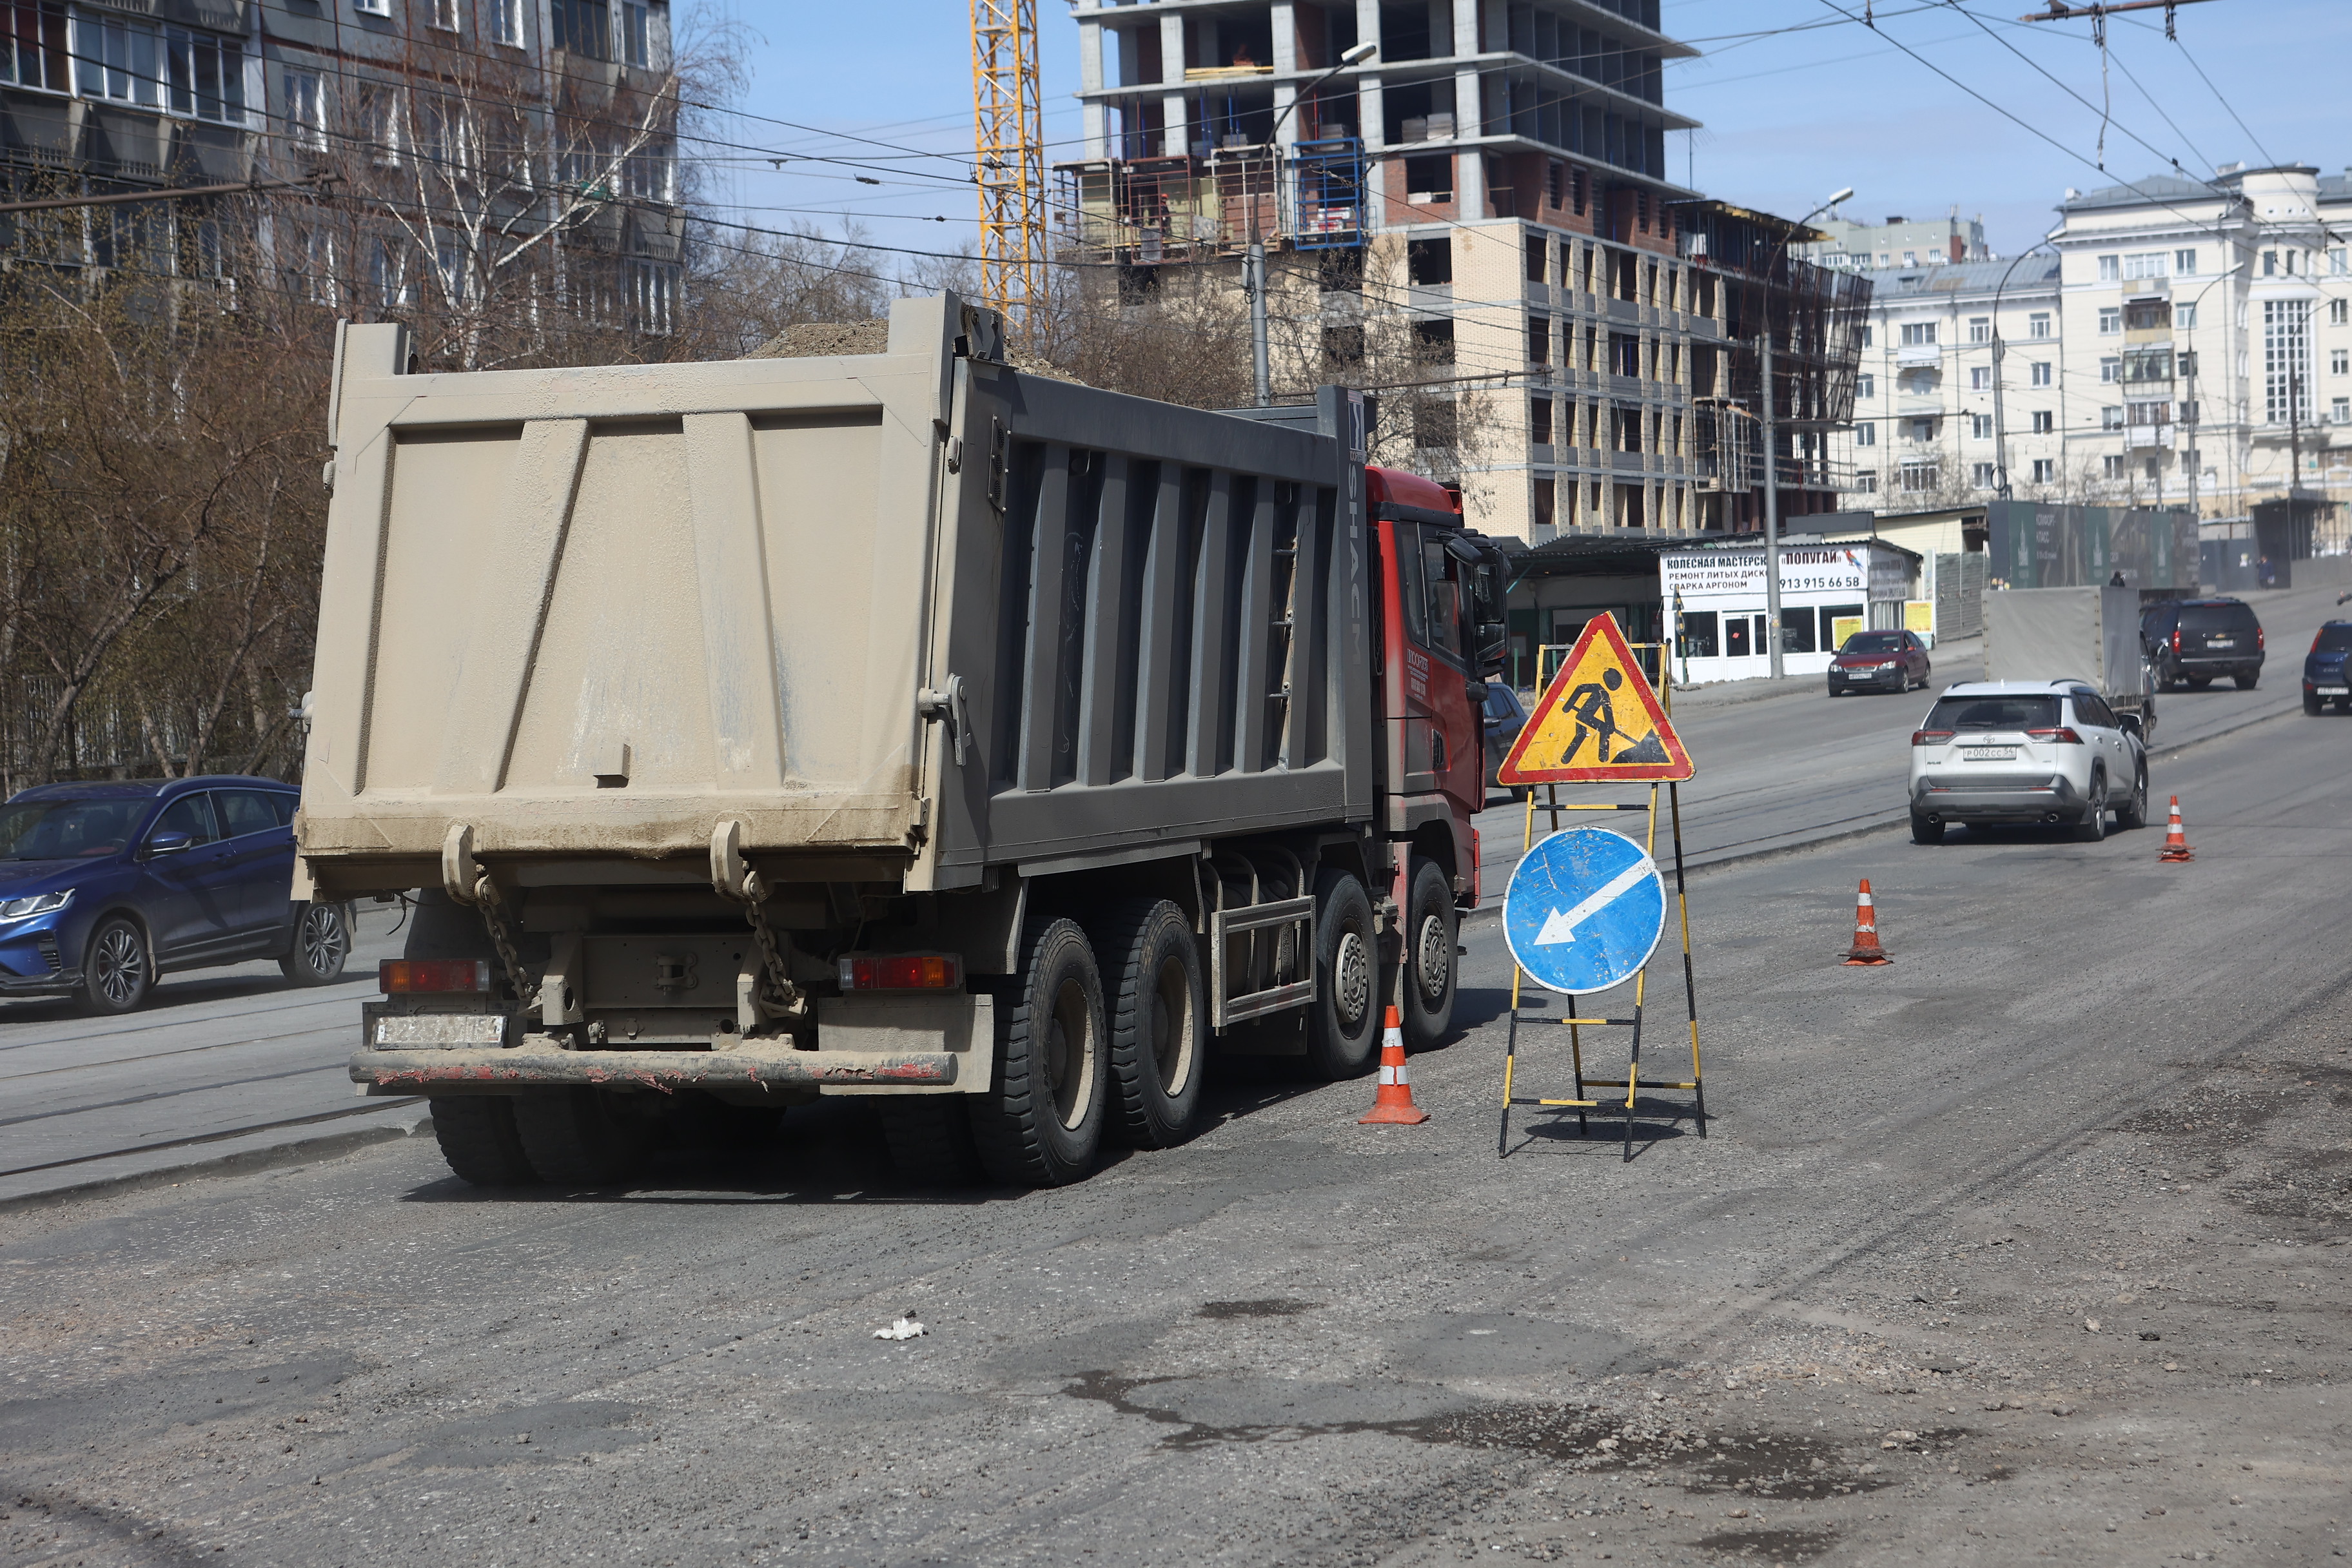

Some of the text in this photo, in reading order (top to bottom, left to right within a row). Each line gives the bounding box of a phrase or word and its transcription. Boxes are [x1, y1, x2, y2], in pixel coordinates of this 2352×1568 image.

[1348, 463, 1361, 665] SHACM
[1667, 549, 1841, 570] КОЛЕСНАЯ МАСТЕРСК «ПОПУГАЙ»
[1669, 569, 1767, 580] РЕМОНТ ЛИТЫХ ДИСК
[1705, 581, 1747, 589] АРГОНОМ
[1779, 578, 1800, 589] 913
[1804, 578, 1825, 588] 915
[1828, 577, 1842, 587] 66
[1846, 576, 1859, 587] 58
